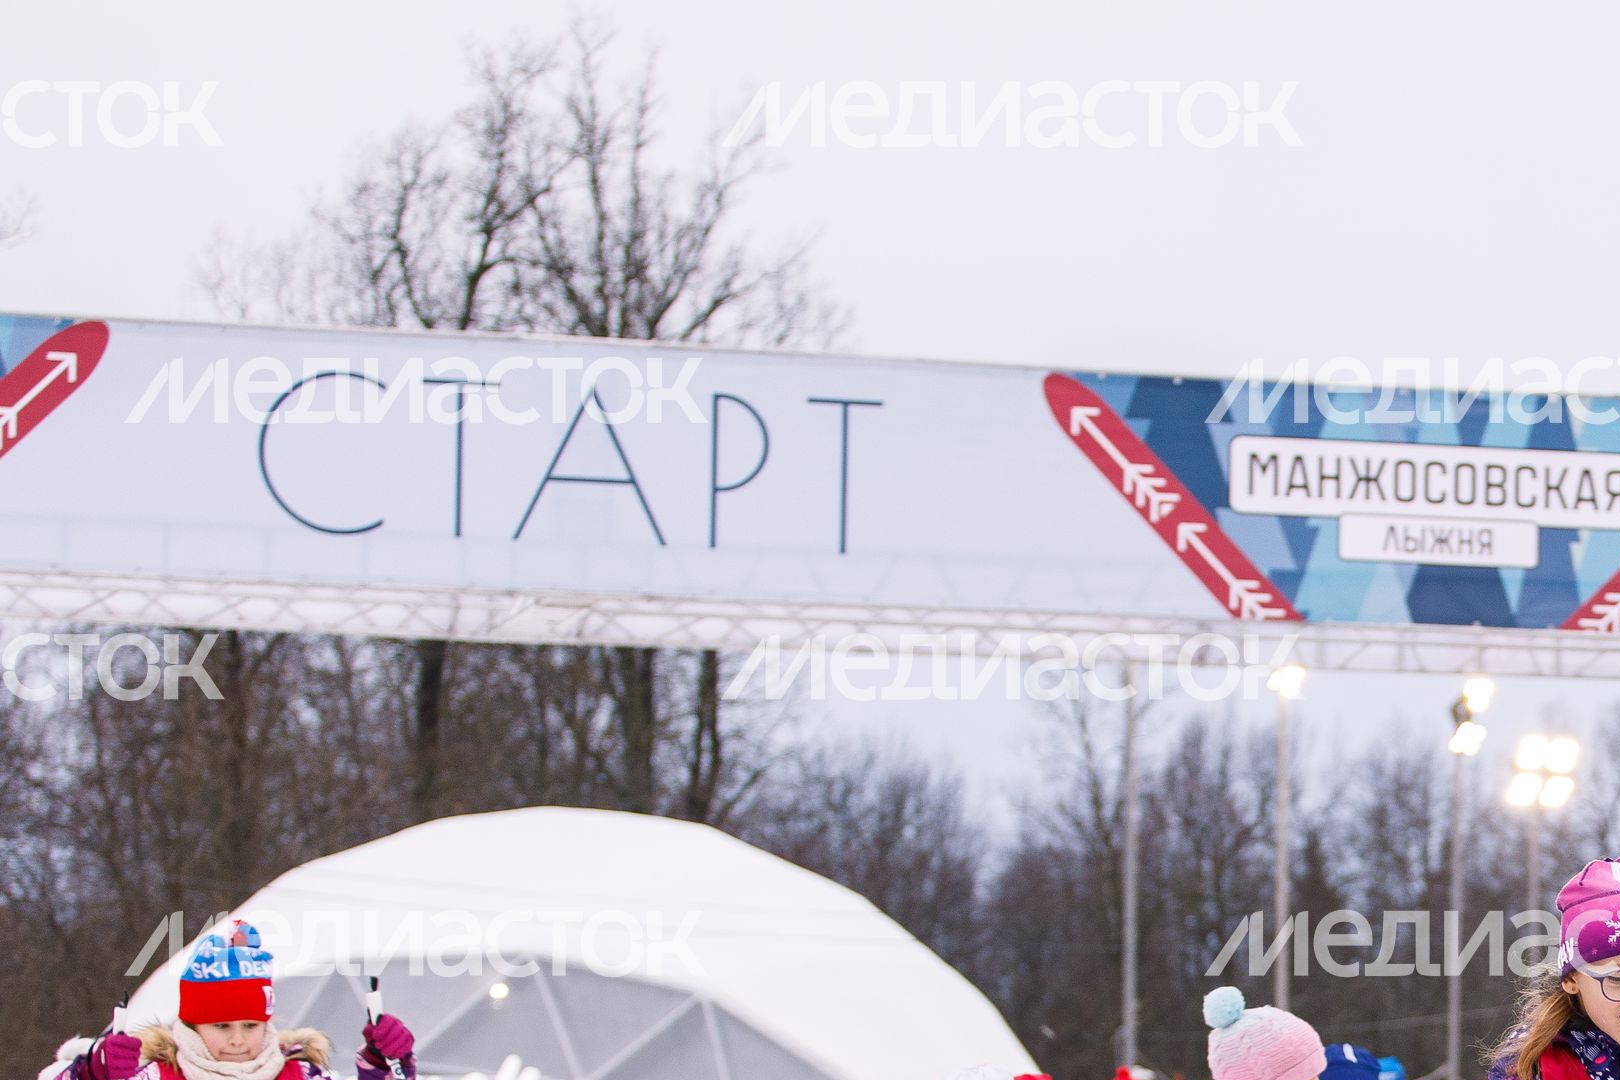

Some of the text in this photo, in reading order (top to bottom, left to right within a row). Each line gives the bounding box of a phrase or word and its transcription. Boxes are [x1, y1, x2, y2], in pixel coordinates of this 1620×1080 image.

[259, 372, 883, 555] СТАРТ
[1381, 525, 1494, 558] ЛЫЖНЯ
[190, 961, 231, 979] SKI
